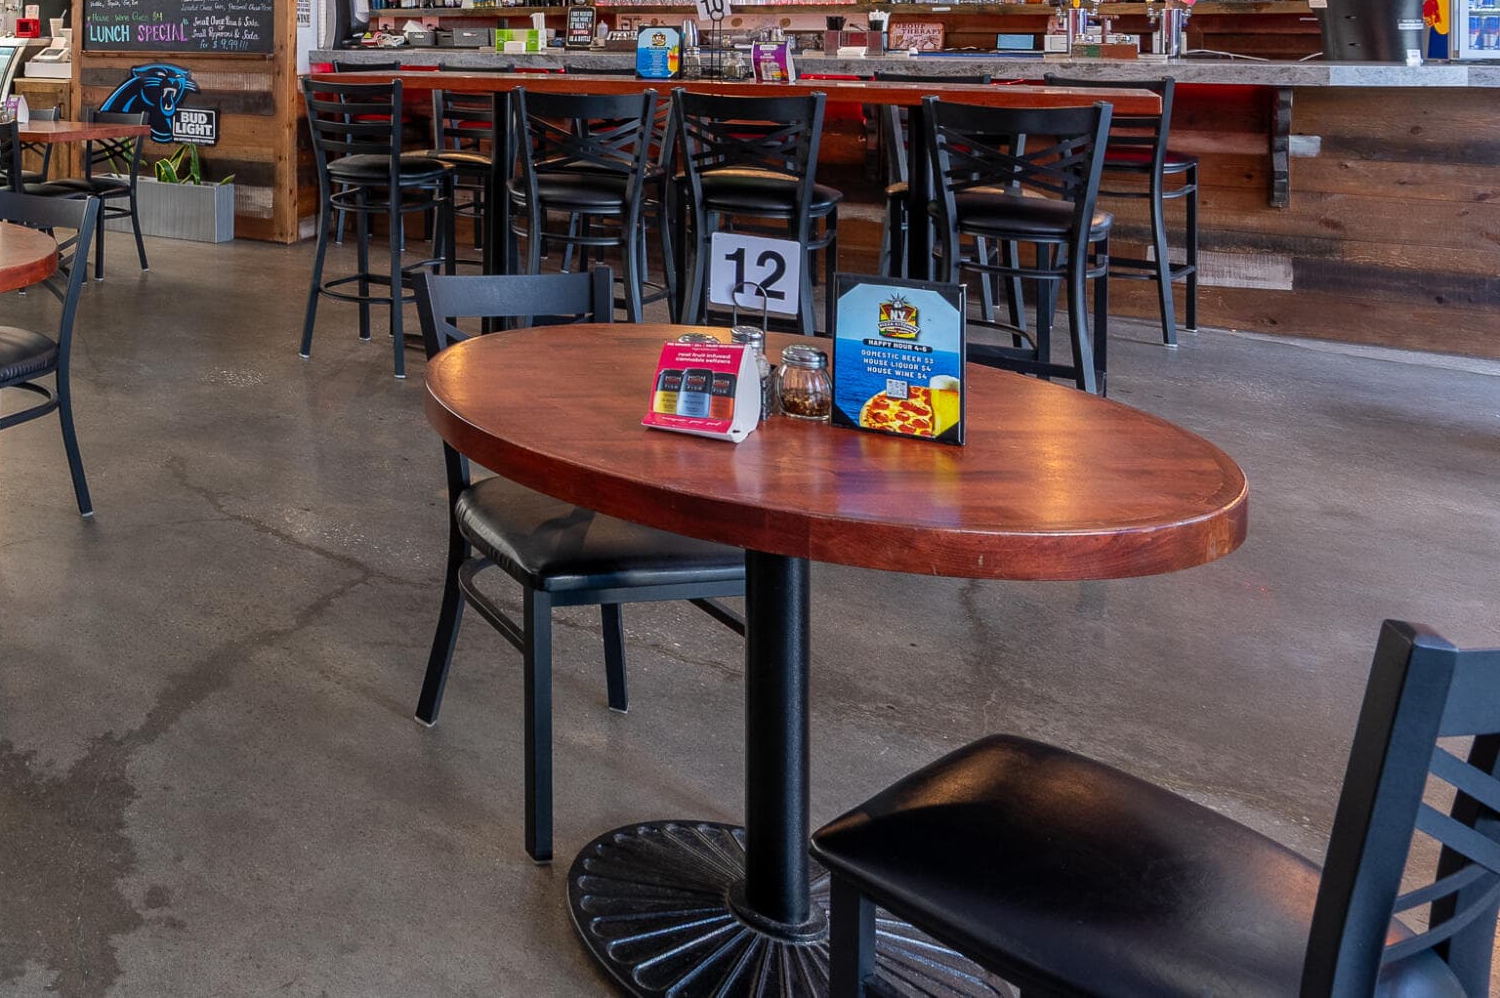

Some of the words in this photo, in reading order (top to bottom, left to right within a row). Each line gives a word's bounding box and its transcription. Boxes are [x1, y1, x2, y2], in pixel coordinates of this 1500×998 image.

[90, 24, 130, 42] LUNCH
[138, 23, 188, 42] SPECIAL
[180, 112, 208, 124] BUD
[175, 122, 212, 136] LIGHT
[724, 248, 787, 300] 12
[868, 339, 891, 348] HAPPY
[861, 349, 899, 360] DOMESTIC
[902, 354, 921, 363] BEER
[863, 358, 888, 366] HOUSE
[891, 362, 918, 371] LIQUOR
[867, 367, 892, 375] HOUSE
[895, 370, 914, 378] WINE
